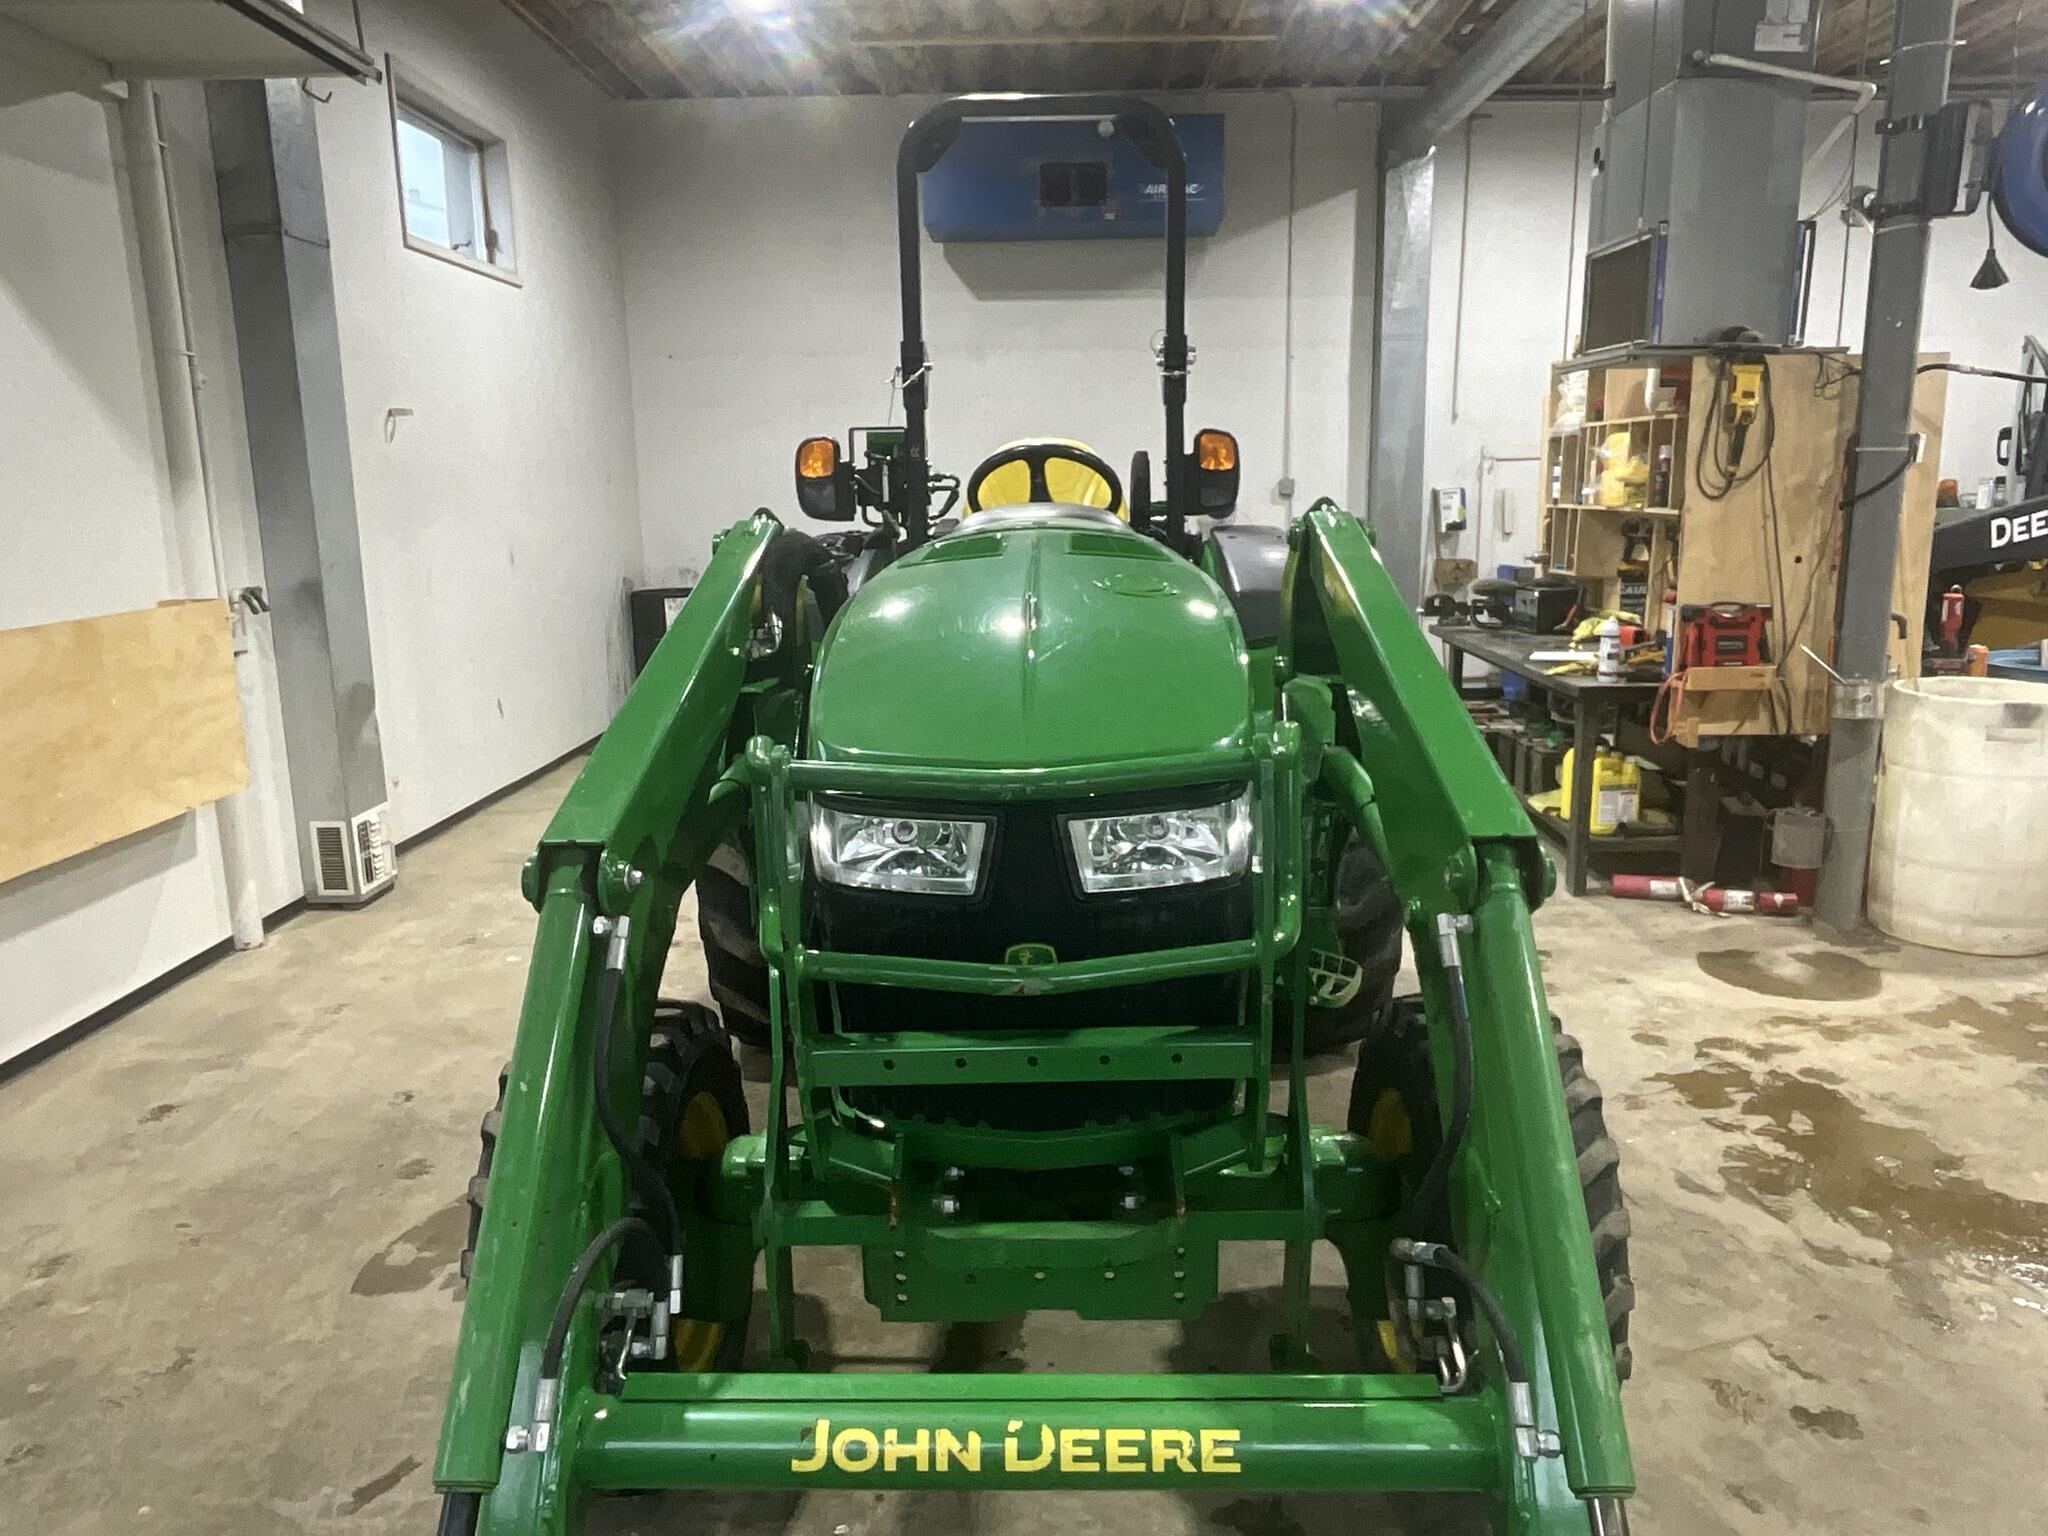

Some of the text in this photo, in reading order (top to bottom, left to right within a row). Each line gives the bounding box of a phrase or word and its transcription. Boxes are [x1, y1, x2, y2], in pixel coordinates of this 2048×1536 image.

[1990, 509, 2048, 549] DEE
[791, 1418, 1242, 1472] JOHN DEERE
